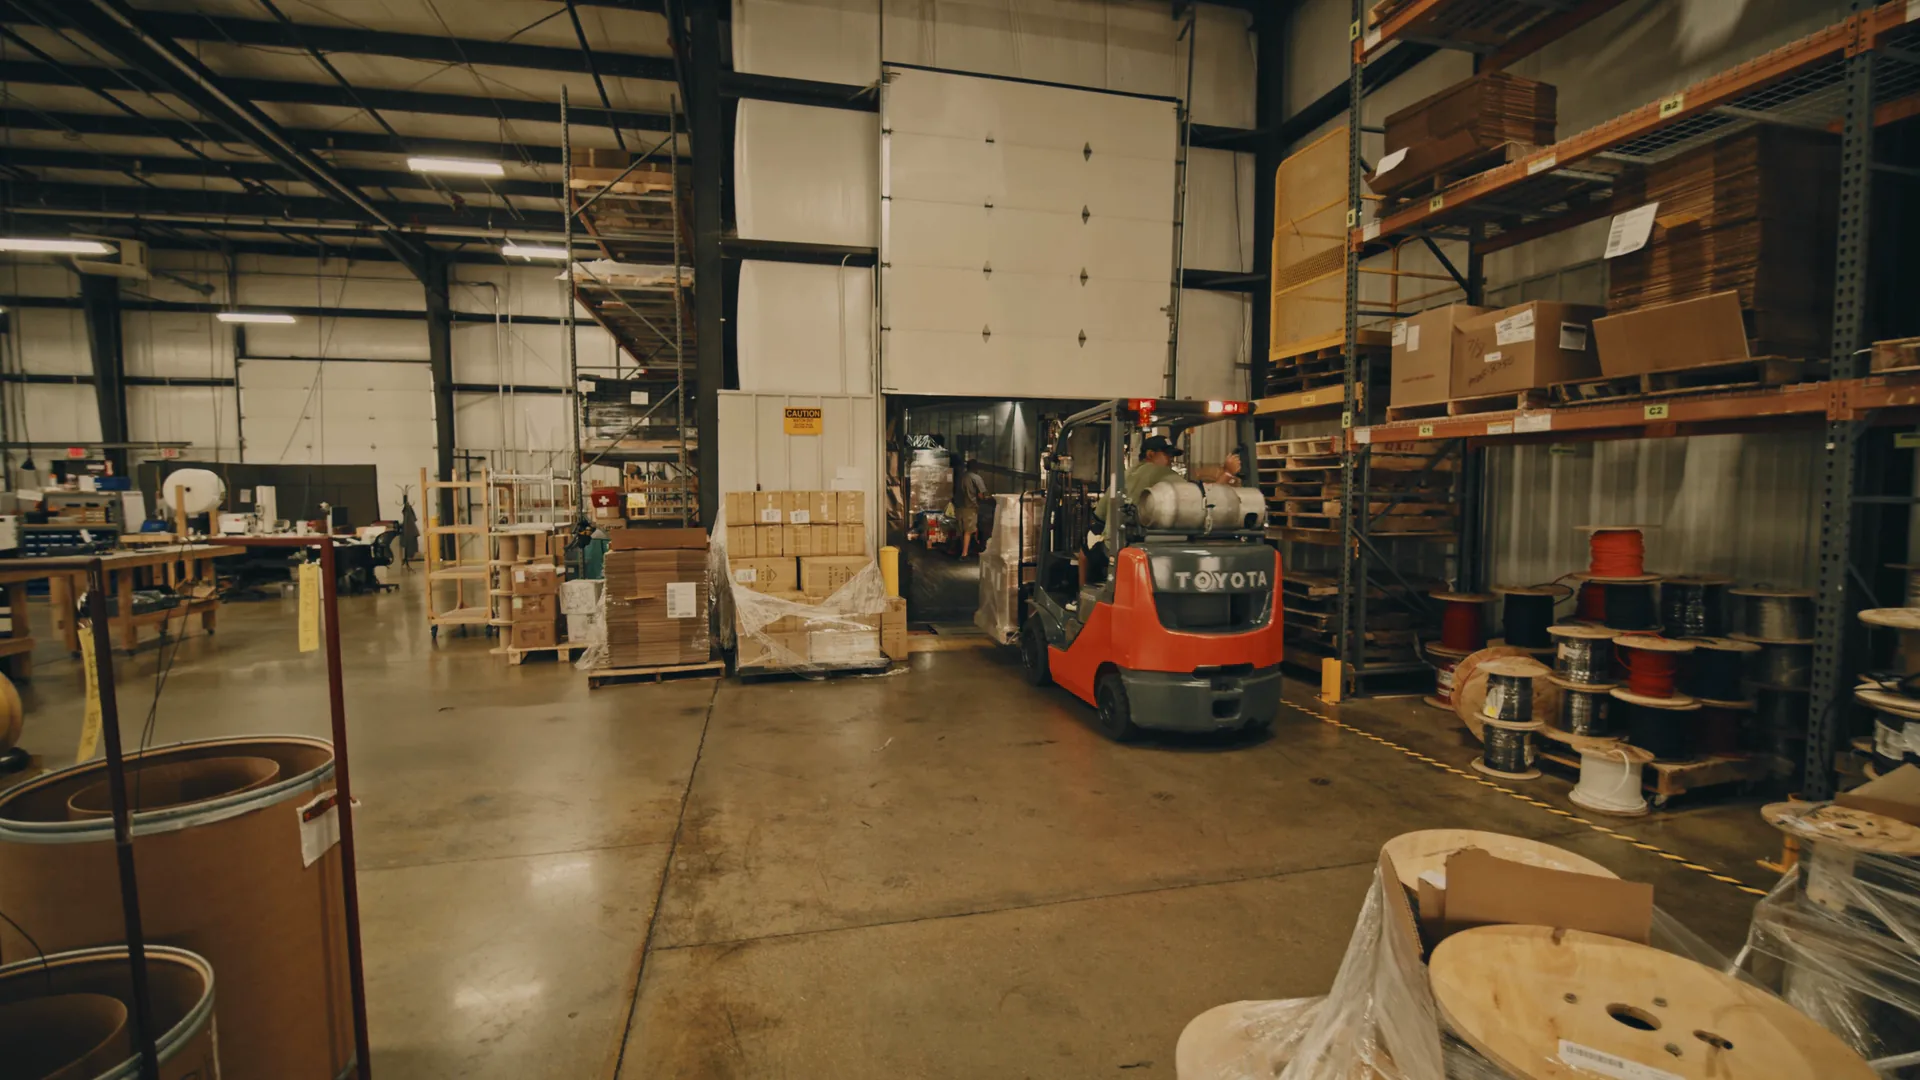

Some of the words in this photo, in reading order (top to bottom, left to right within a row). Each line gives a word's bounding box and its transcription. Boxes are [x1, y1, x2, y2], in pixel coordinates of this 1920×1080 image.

[786, 410, 820, 418] CAUTION
[1649, 406, 1663, 415] C2
[1422, 426, 1431, 434] C1
[1174, 570, 1268, 590] TOYOTA
